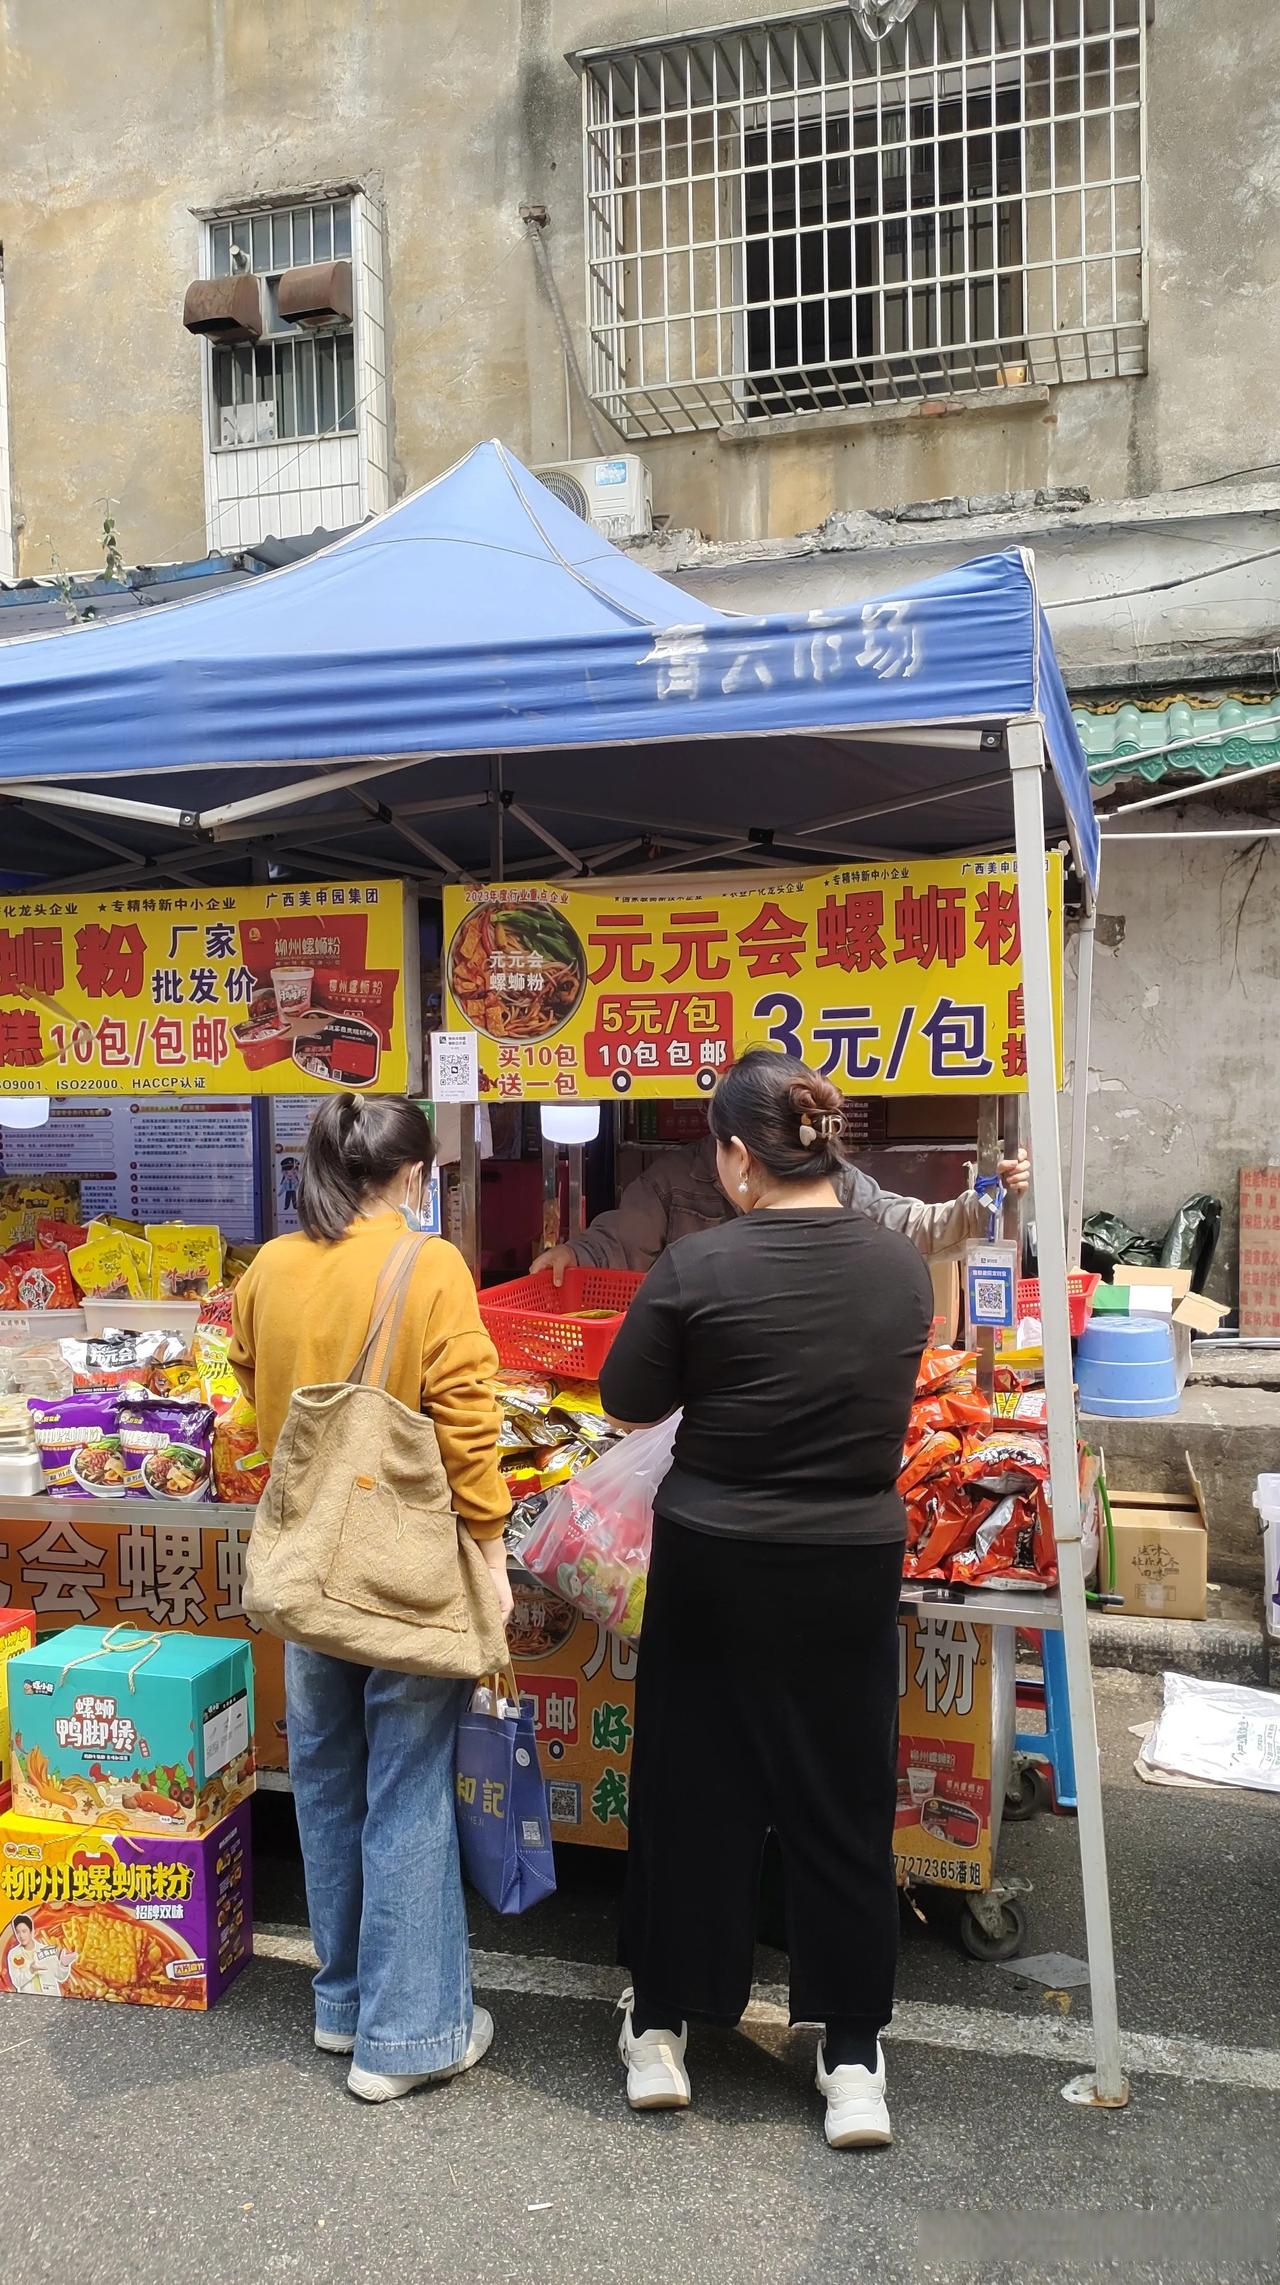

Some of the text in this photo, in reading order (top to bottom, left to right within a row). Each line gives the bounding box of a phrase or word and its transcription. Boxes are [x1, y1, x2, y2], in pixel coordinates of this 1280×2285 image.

[832, 867, 909, 886] 专精特新中小企业
[961, 859, 1048, 876] 广西美申
[112, 897, 236, 913] 专精特新中小企业
[265, 888, 378, 909] 广西美申园集团
[466, 888, 569, 904] 2023年度行业重点企业
[0, 903, 78, 918] 化龙头企业
[168, 922, 237, 959] 厂家
[587, 881, 1051, 985] 元元会螺蛳粉
[489, 950, 544, 968] 元元会
[151, 964, 258, 1004] 批发价
[489, 972, 544, 991] 螺蛳粉
[602, 996, 720, 1036] 5元/包
[753, 992, 993, 1080] 3元/包
[498, 1043, 578, 1069] 买10包
[599, 1038, 727, 1068] 10包包邮
[0, 1076, 206, 1091] O9001、ISO22000、HACCP认证
[498, 1071, 578, 1098] 送一包
[0, 1521, 258, 1634] 会螺
[898, 1618, 981, 1716] 粉
[75, 1697, 115, 1719] 螺蛳
[56, 1717, 135, 1750] 鸭脚煲
[1, 1861, 191, 1900] 柳州螺蛳粉
[135, 1903, 184, 1920] 招牌双味
